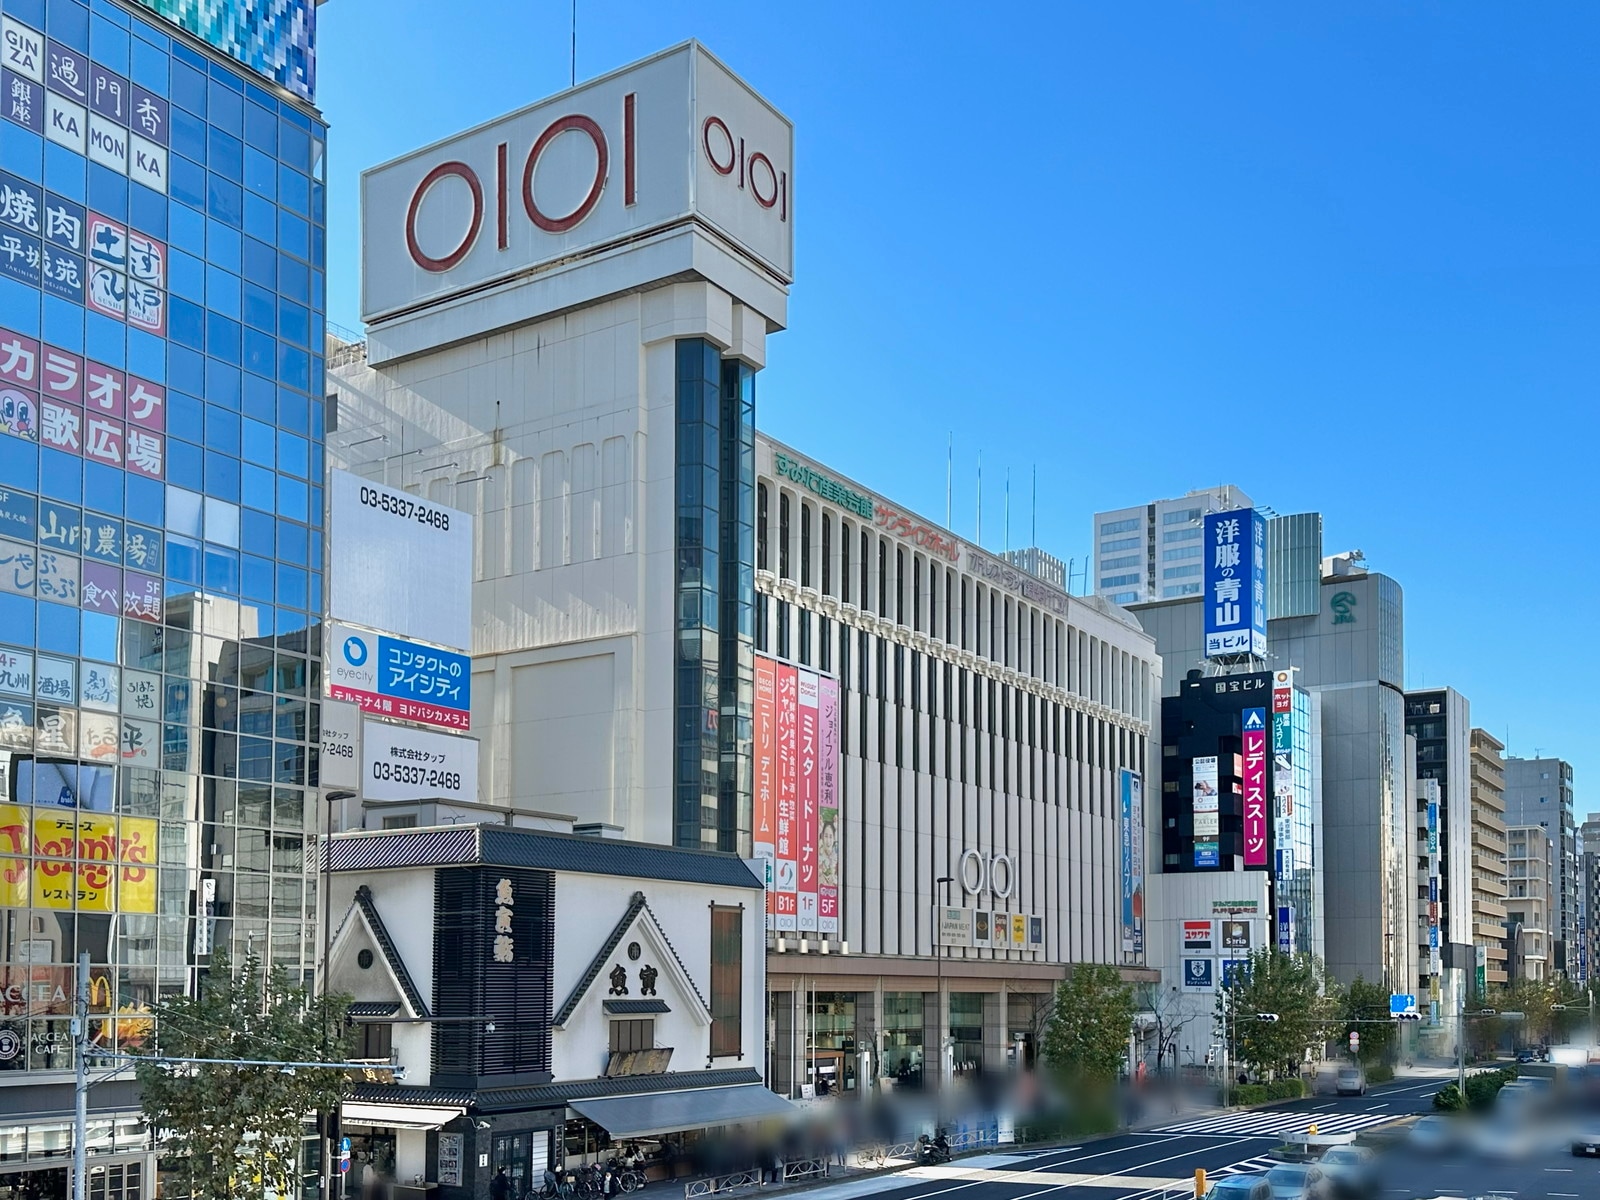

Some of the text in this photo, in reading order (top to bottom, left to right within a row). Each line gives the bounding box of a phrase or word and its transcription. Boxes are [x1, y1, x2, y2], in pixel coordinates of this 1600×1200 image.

[5, 29, 38, 56] GIN
[10, 47, 35, 71] ZA
[11, 77, 31, 125] 銀座
[51, 53, 161, 136] 過門香
[53, 108, 161, 177] KA MON KA
[0, 184, 81, 249] 焼肉
[0, 339, 162, 420] カラオケ
[42, 401, 162, 475] 歌広場
[360, 486, 450, 531] 03-5337-2468
[1214, 518, 1242, 627] 洋服の青山
[83, 581, 161, 622] 食べ放題
[1209, 635, 1249, 651] 当ビル
[337, 666, 374, 685] eyecity
[389, 648, 462, 678] コンタクトの
[0, 669, 71, 699] 九州酒場
[389, 666, 462, 701] アイシティ
[1216, 678, 1265, 693] 国宝ビル
[399, 703, 469, 728] ヨドバシカメラ上
[761, 704, 770, 749] ニトリ
[390, 746, 446, 764] 株式会社タップ
[373, 761, 461, 790] 03-5337-2468
[802, 713, 814, 884] ミスタードーナツ
[1246, 736, 1264, 853] レディススーツ
[0, 822, 147, 889] Denny's
[43, 889, 97, 901] レストラン
[778, 895, 795, 912] B1F
[802, 896, 813, 910] 1F
[821, 899, 835, 913] 5F
[1226, 937, 1247, 945] Seria
[31, 1032, 69, 1042] ACCEA
